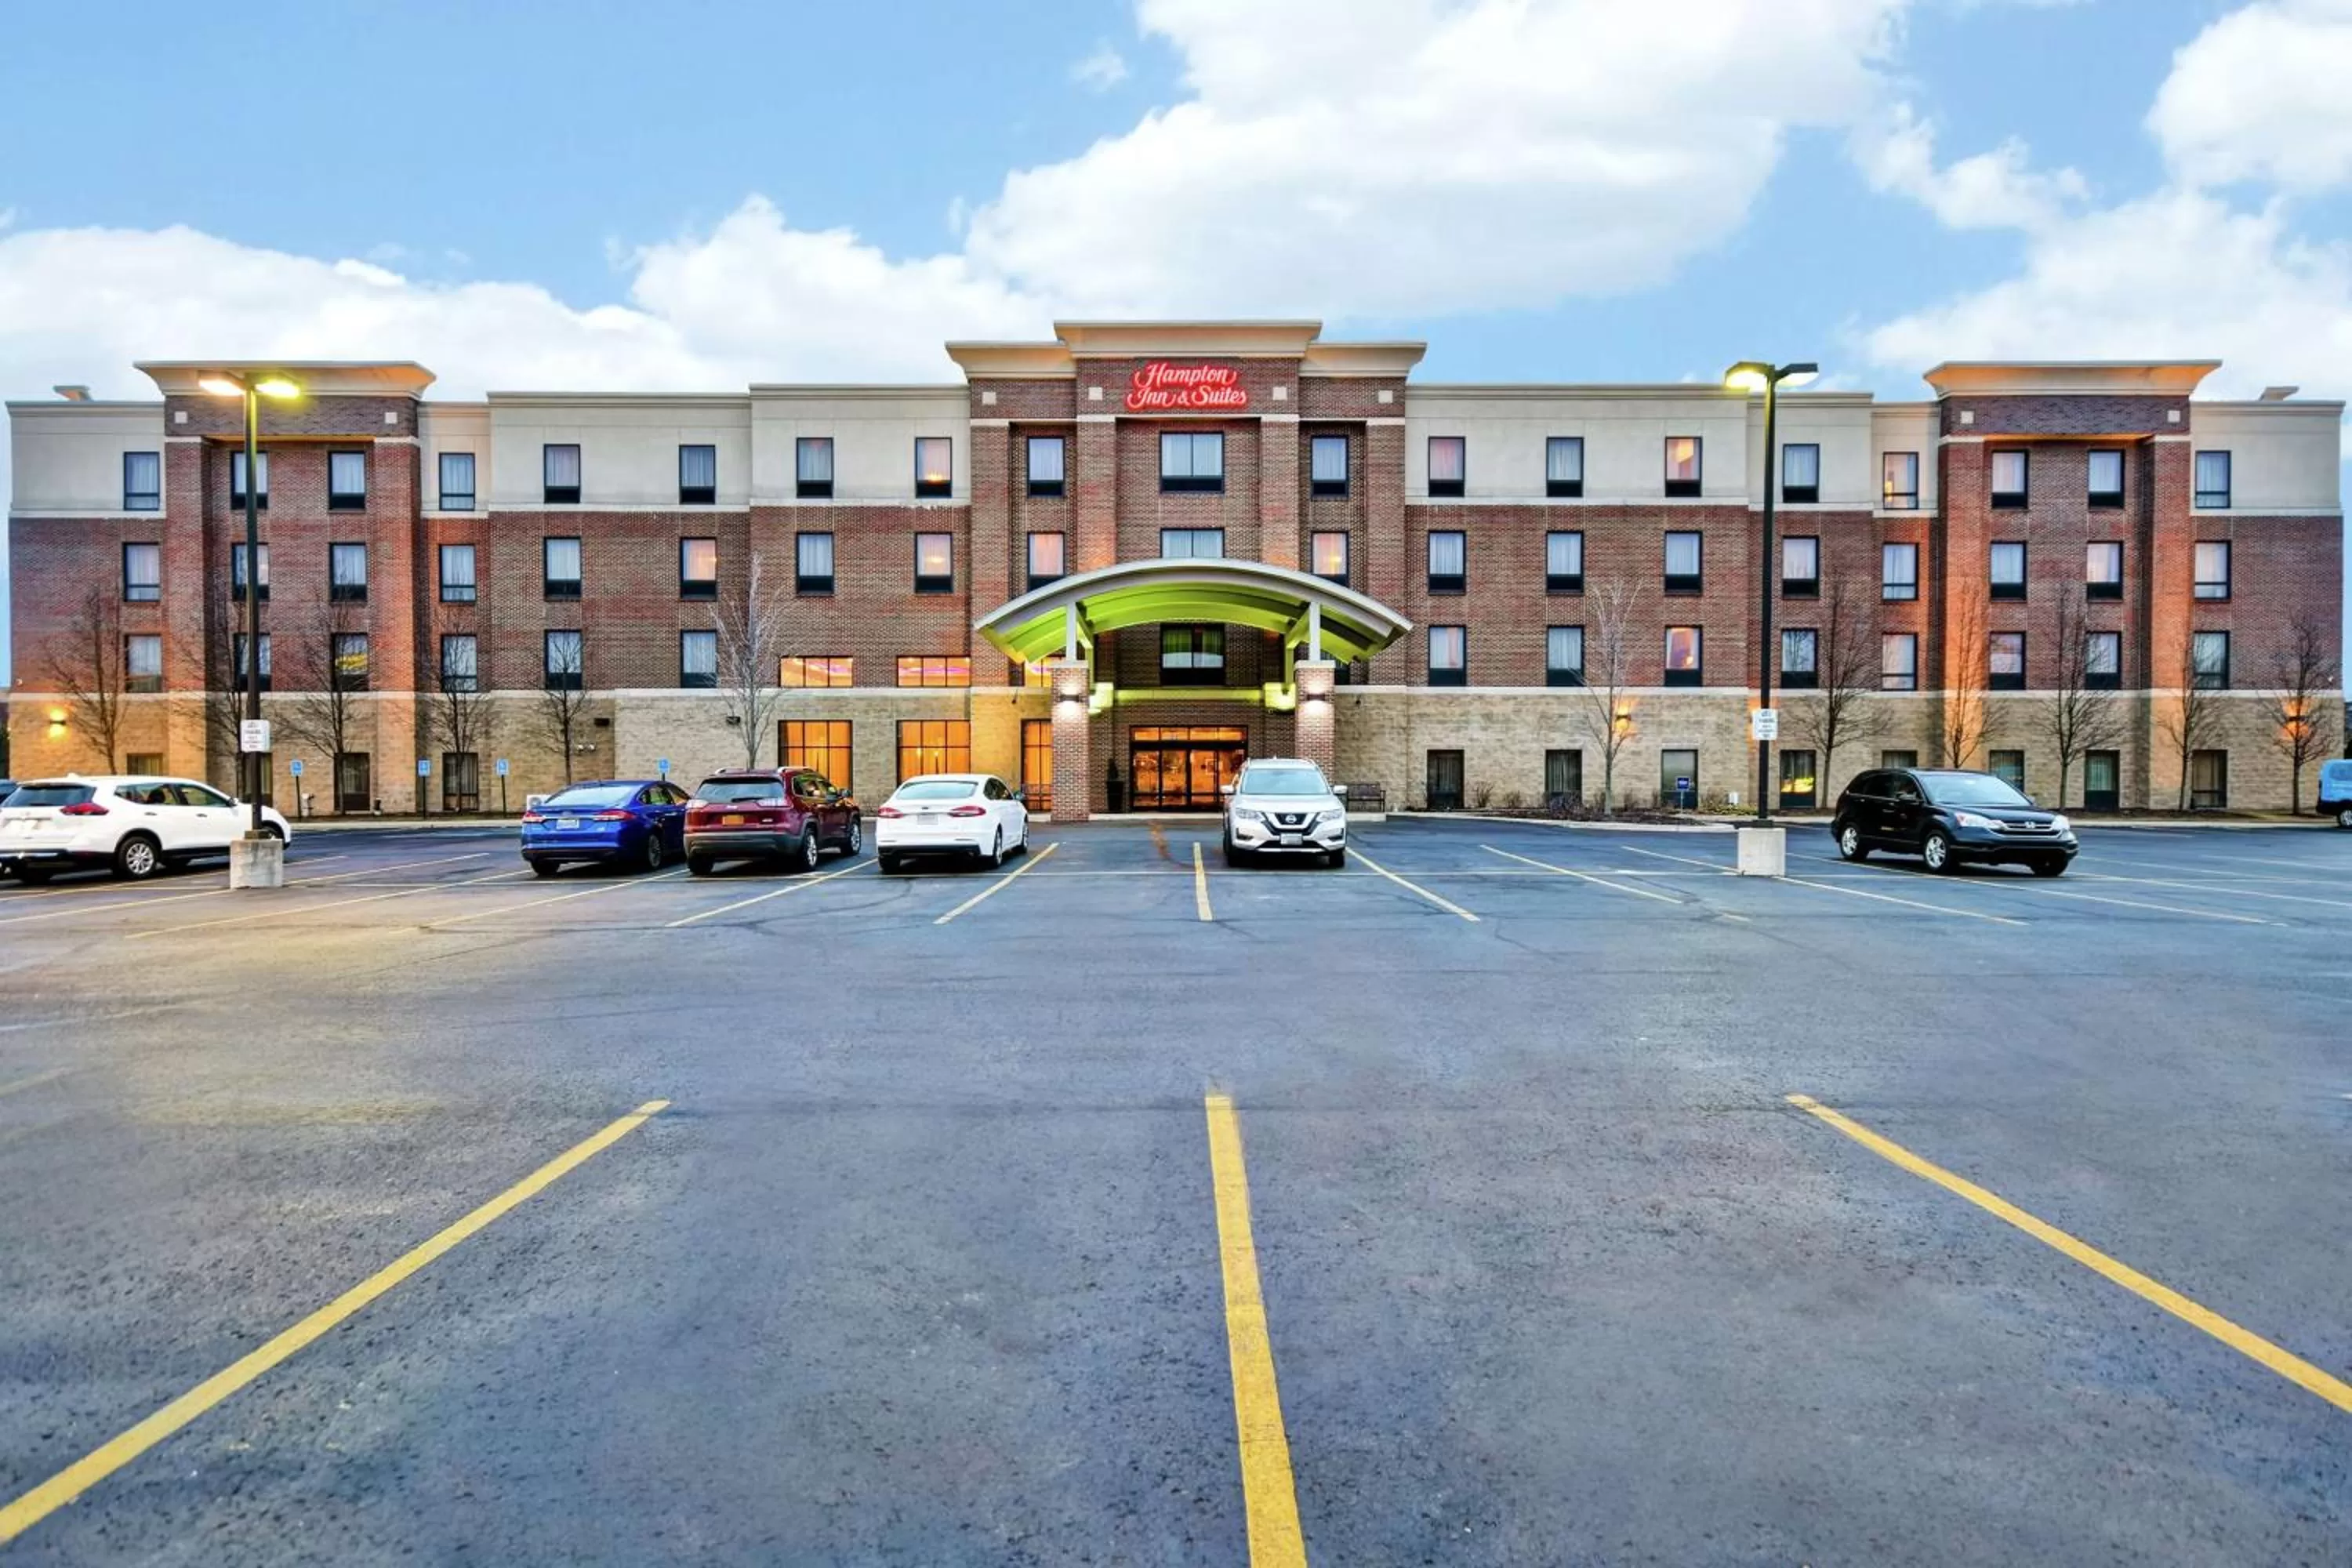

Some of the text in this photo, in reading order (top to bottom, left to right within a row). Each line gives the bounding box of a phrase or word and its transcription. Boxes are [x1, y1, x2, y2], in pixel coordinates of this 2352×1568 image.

[1134, 362, 1237, 387] Hampton
[1127, 385, 1247, 408] Inn & Suites
